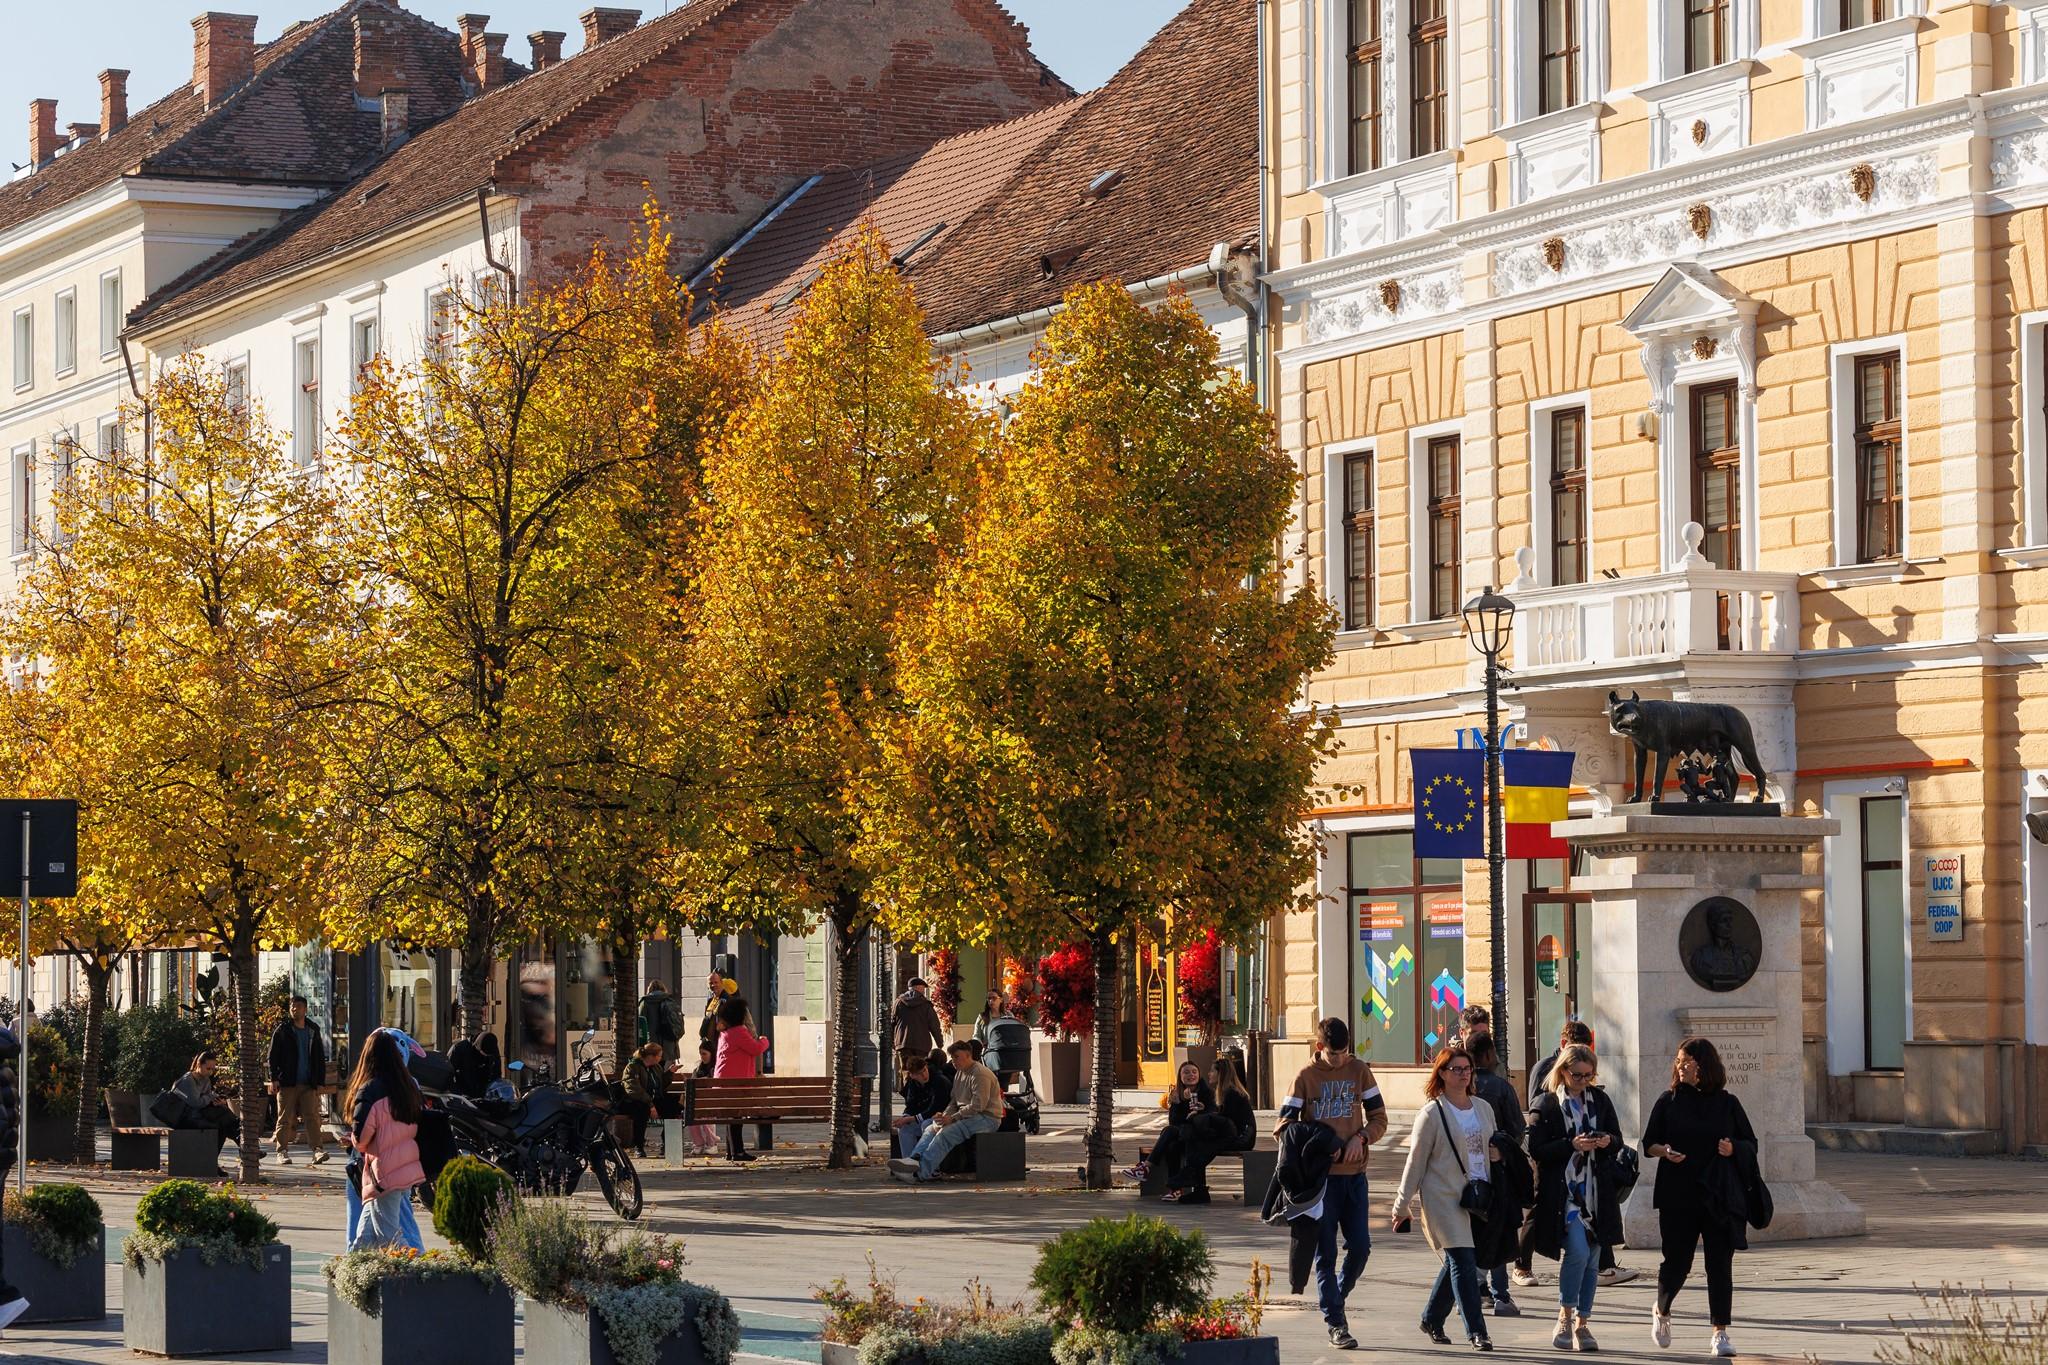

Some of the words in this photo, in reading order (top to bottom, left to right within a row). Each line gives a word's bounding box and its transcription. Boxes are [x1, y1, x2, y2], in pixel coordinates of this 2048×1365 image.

[1933, 877, 1953, 891] UJCC
[1928, 905, 1959, 917] FEDERAL
[1935, 921, 1953, 933] COOP
[1719, 1043, 1741, 1051] ALLA
[1321, 1080, 1355, 1100] NYC
[1313, 1096, 1353, 1120] VIBE
